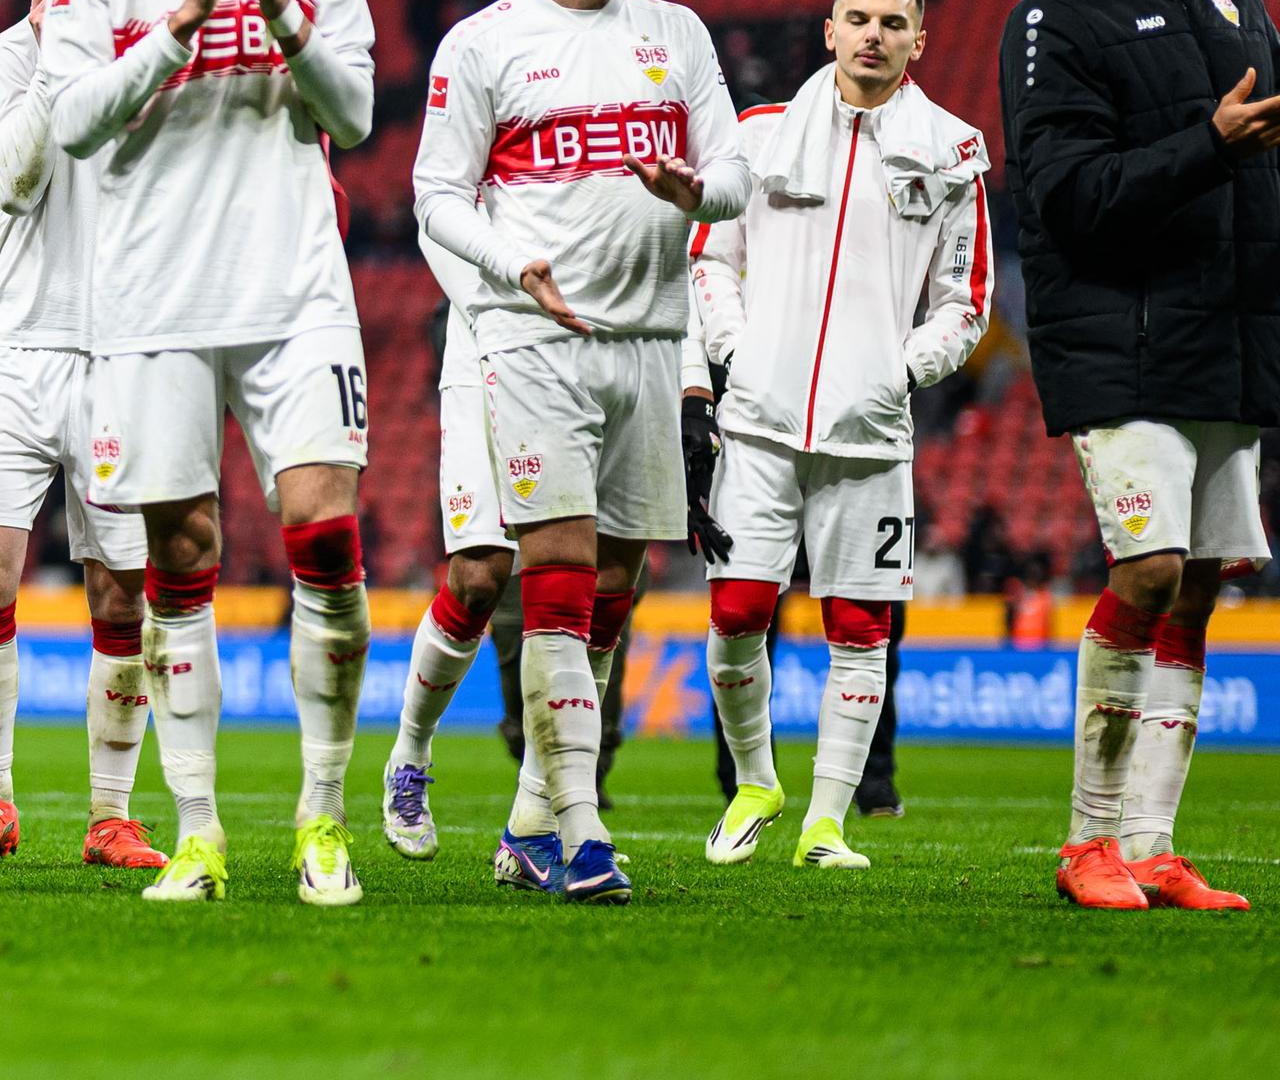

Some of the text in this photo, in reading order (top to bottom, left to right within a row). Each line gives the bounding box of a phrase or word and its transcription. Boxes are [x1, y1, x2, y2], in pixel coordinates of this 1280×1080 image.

[1136, 15, 1166, 31] JAKO
[526, 68, 560, 83] JAKO
[330, 364, 367, 429] 16
[104, 690, 148, 705] VfB
[548, 699, 594, 711] VfB
[841, 693, 879, 704] VfB
